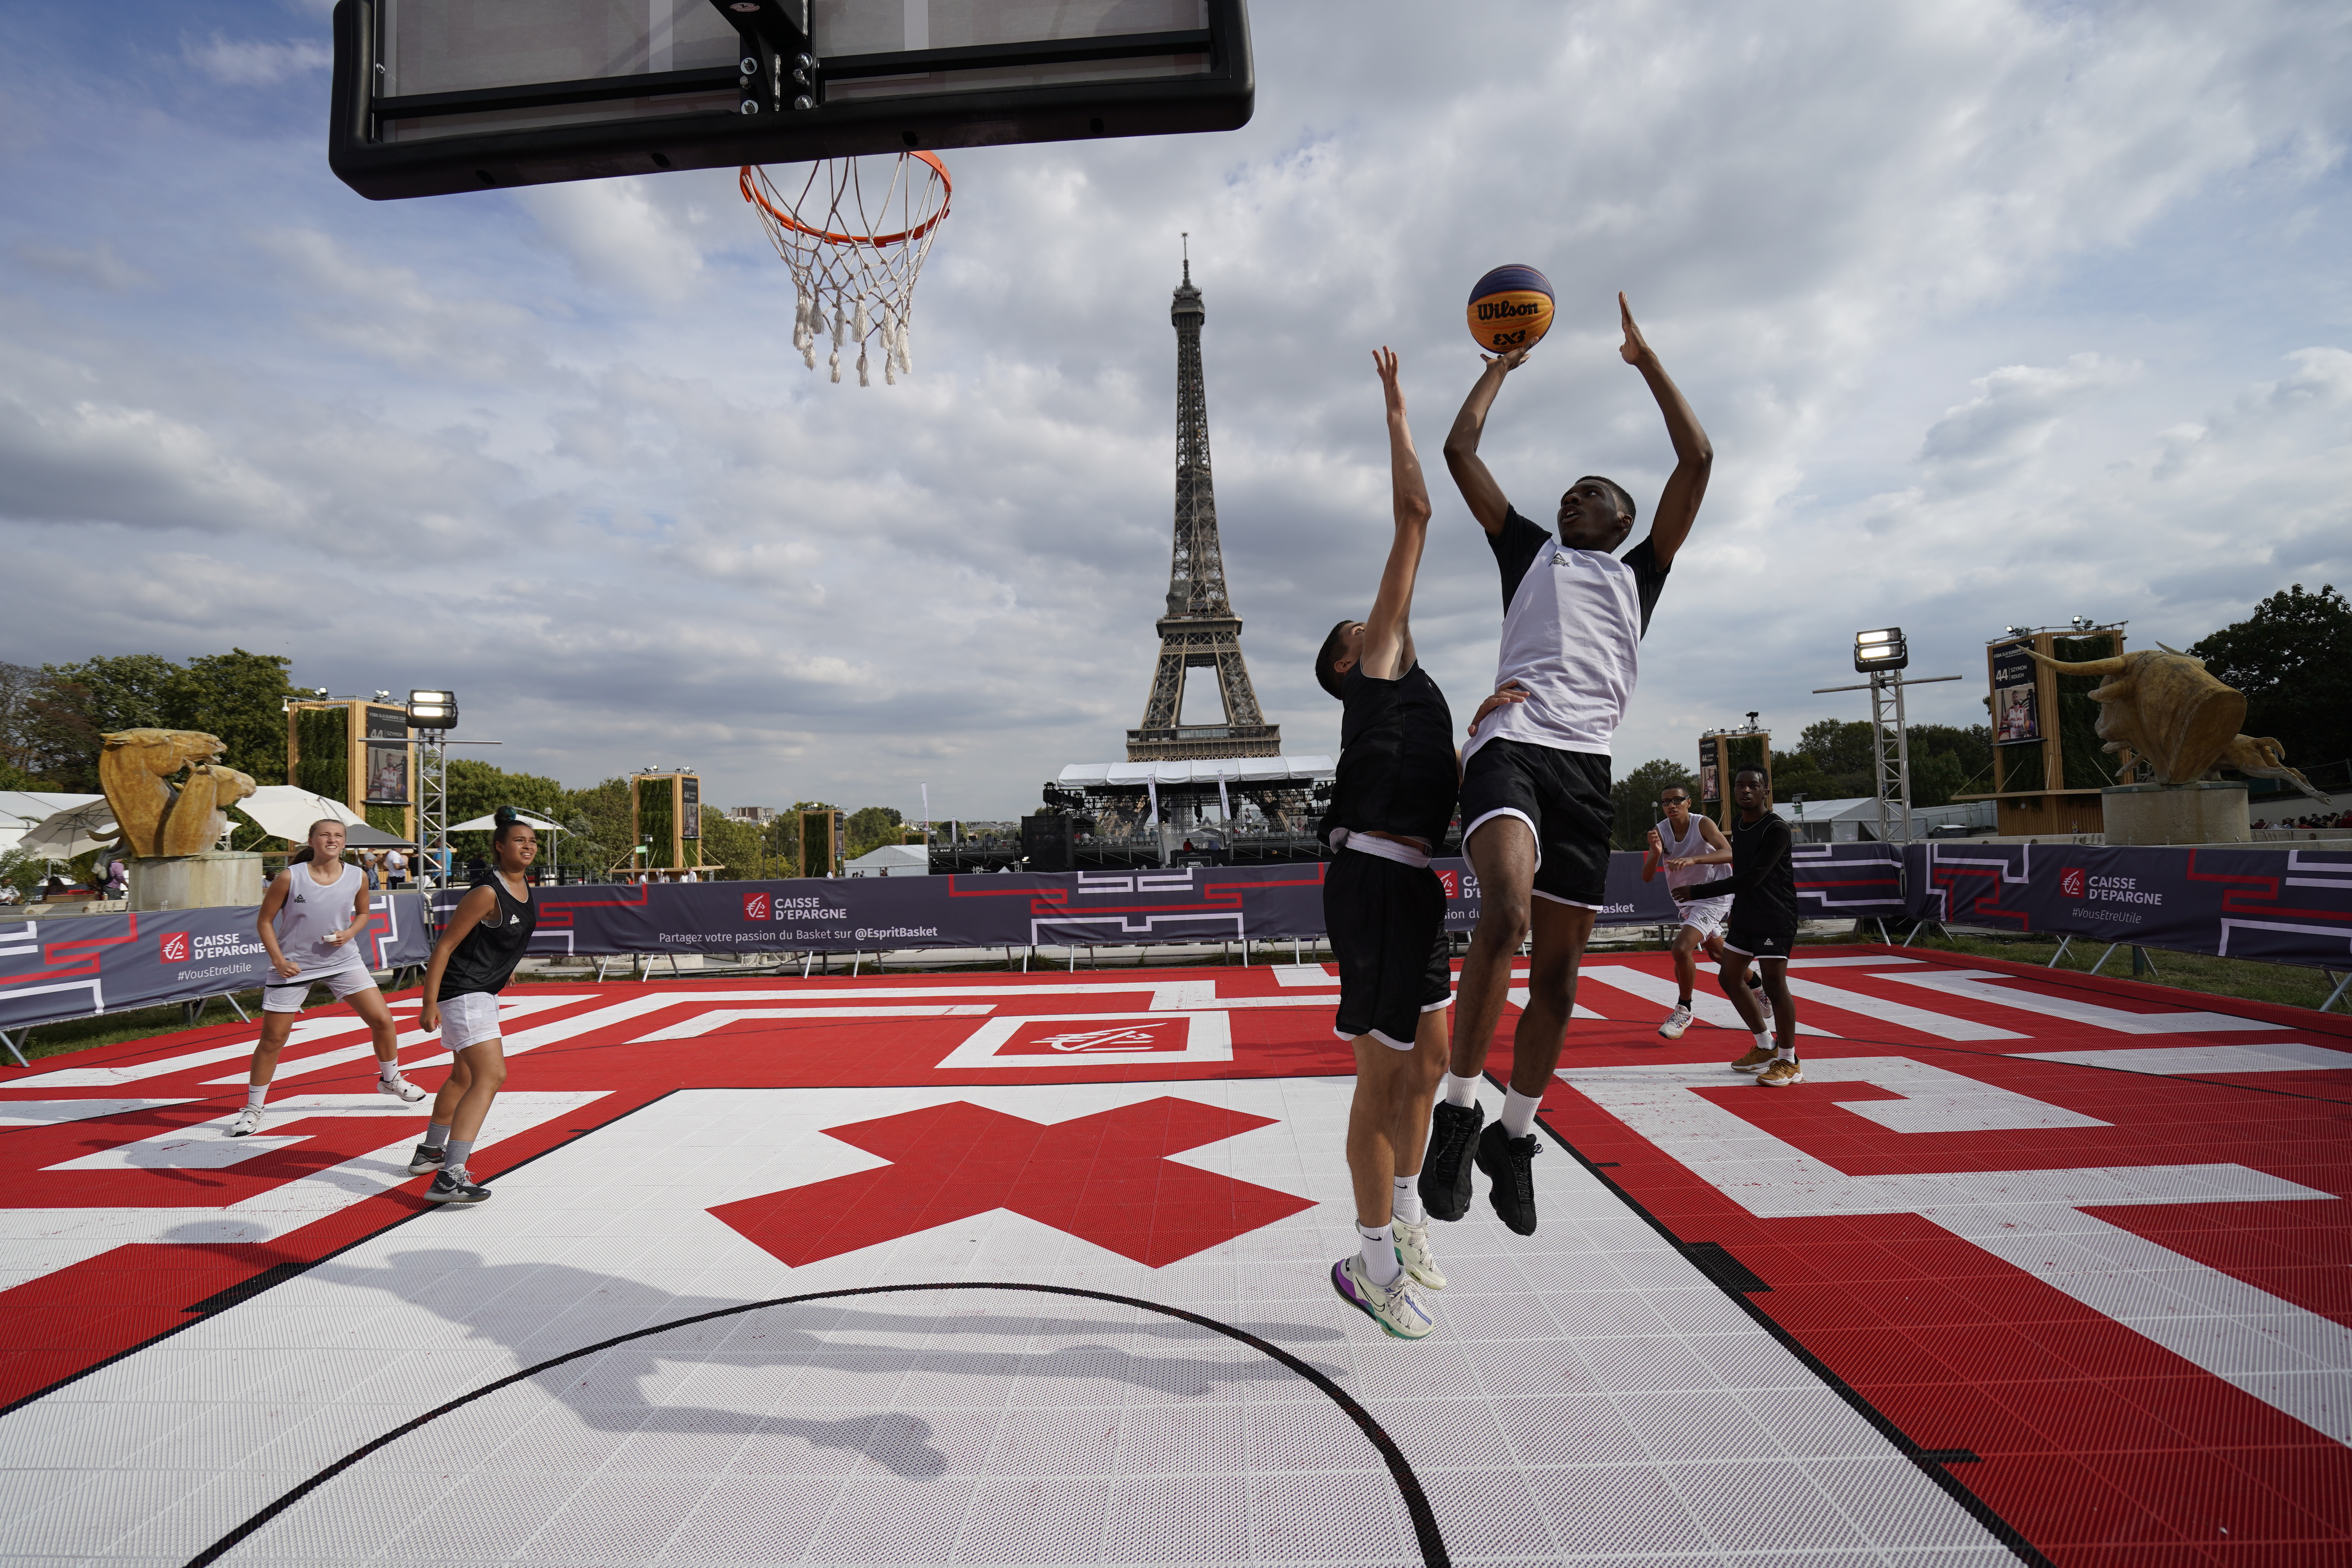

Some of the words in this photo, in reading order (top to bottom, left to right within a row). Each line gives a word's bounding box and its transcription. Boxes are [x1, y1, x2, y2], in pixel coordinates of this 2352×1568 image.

[1477, 301, 1538, 321] Wilson
[1548, 559, 1570, 568] PEAK
[1996, 668, 2009, 681] 44
[370, 729, 384, 738] 44
[2089, 876, 2136, 889] CAISSE
[775, 898, 820, 909] CAISSE
[2089, 889, 2163, 905] D'EPARGNE
[775, 909, 847, 920] D'EPARGNE
[2072, 907, 2141, 924] #VousEtreUtile
[194, 933, 240, 948] CAISSE
[659, 933, 702, 944] Partagez
[705, 933, 732, 942] votre
[736, 930, 775, 944] passion
[779, 930, 793, 940] du
[797, 929, 831, 939] Basket
[834, 930, 852, 938] sur
[855, 926, 938, 941] @EspritBasket
[195, 943, 266, 960] D'EPARGNE
[178, 963, 252, 981] #VousEtreUtile
